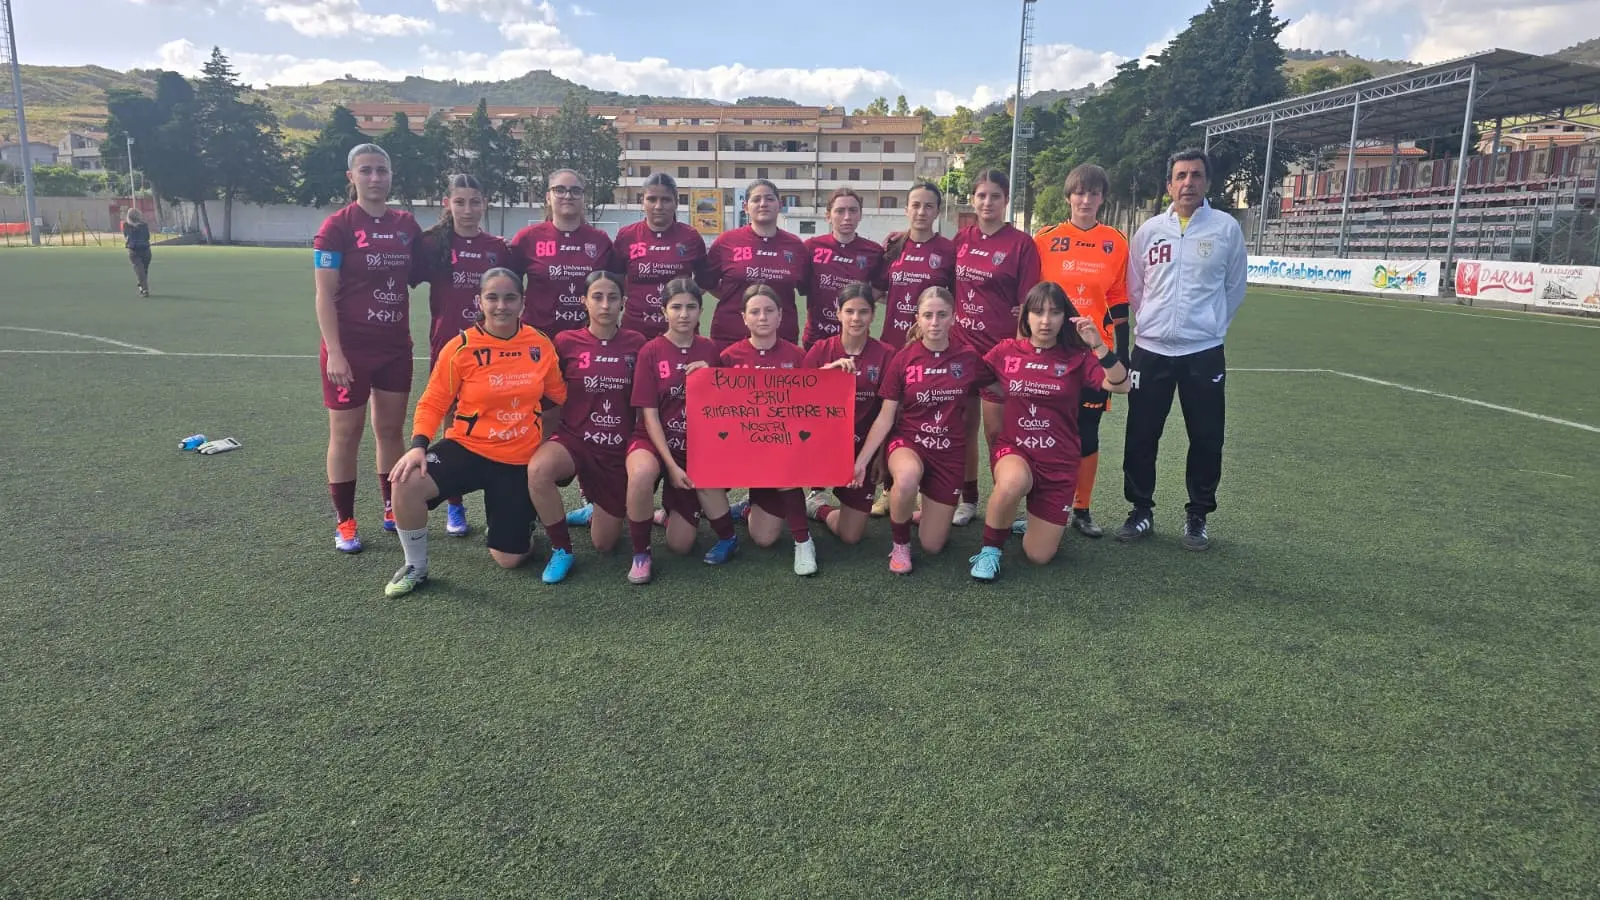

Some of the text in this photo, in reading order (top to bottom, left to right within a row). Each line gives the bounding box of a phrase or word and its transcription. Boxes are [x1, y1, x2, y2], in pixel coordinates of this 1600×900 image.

[354, 230, 369, 248] 2
[1050, 237, 1070, 252] 29
[459, 251, 482, 259] Zeus
[629, 242, 647, 259] 25
[813, 247, 833, 265] 27
[1149, 244, 1172, 266] CA
[320, 253, 332, 267] C
[1481, 268, 1535, 285] DARMA
[373, 289, 404, 301] Cactus
[473, 348, 491, 366] 17
[579, 351, 591, 369] 3
[595, 355, 619, 363] Zeus
[1004, 355, 1021, 373] 13
[659, 360, 671, 378] 9
[924, 367, 947, 375] Zeus
[1025, 362, 1049, 370] Zeus
[712, 369, 756, 389] BUON
[906, 364, 923, 384] 21
[1024, 386, 1051, 396] Pegaso
[1025, 381, 1061, 391] Università
[336, 386, 349, 402] 2
[590, 411, 621, 424] Cactus
[702, 404, 846, 418] RIMARRAI SEMPRE NEI
[740, 421, 787, 432] NOSTRI
[920, 423, 949, 434] Cactus
[1018, 417, 1050, 428] Cactus
